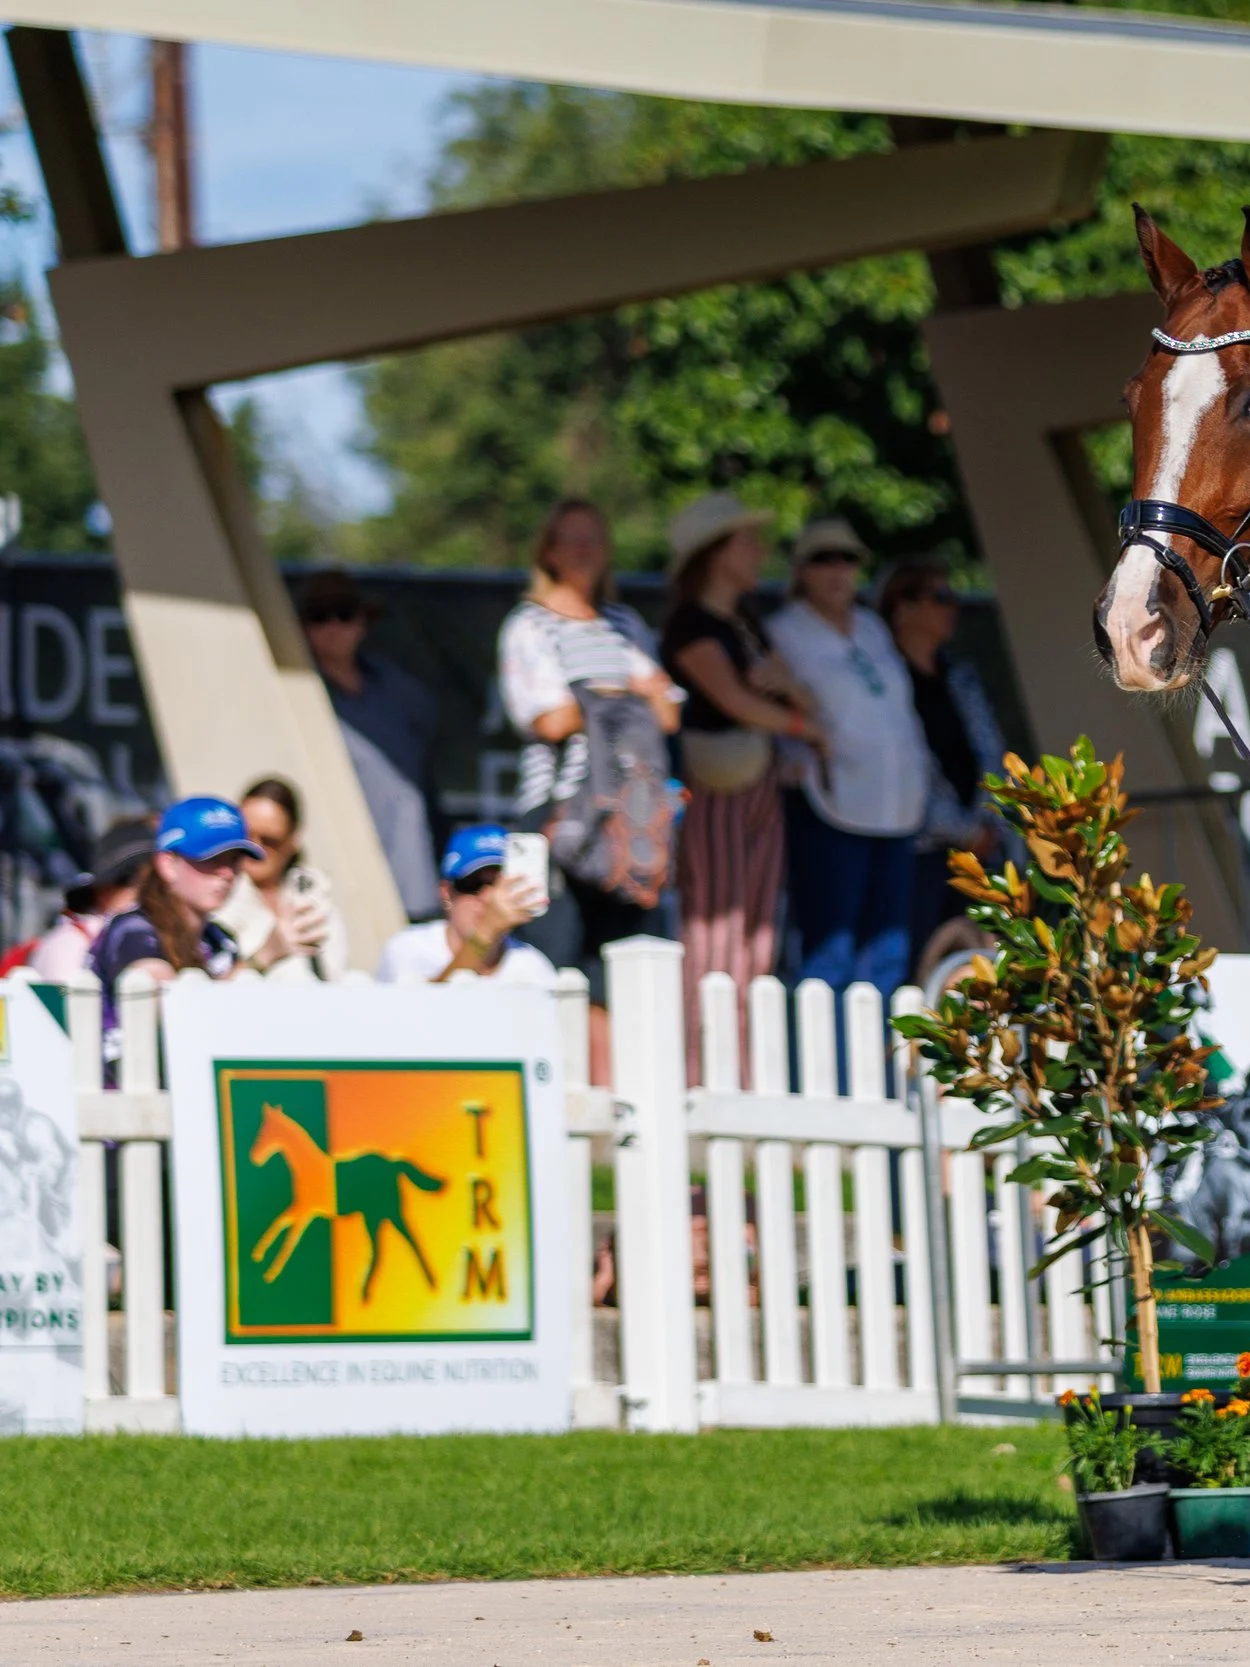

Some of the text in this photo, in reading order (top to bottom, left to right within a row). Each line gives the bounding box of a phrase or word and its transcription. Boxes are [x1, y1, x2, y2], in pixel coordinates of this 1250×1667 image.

[36, 1271, 64, 1293] BY
[0, 1308, 79, 1331] PIONS
[220, 1358, 540, 1384] EXCELLENCE IN EQUINE NUTRITION
